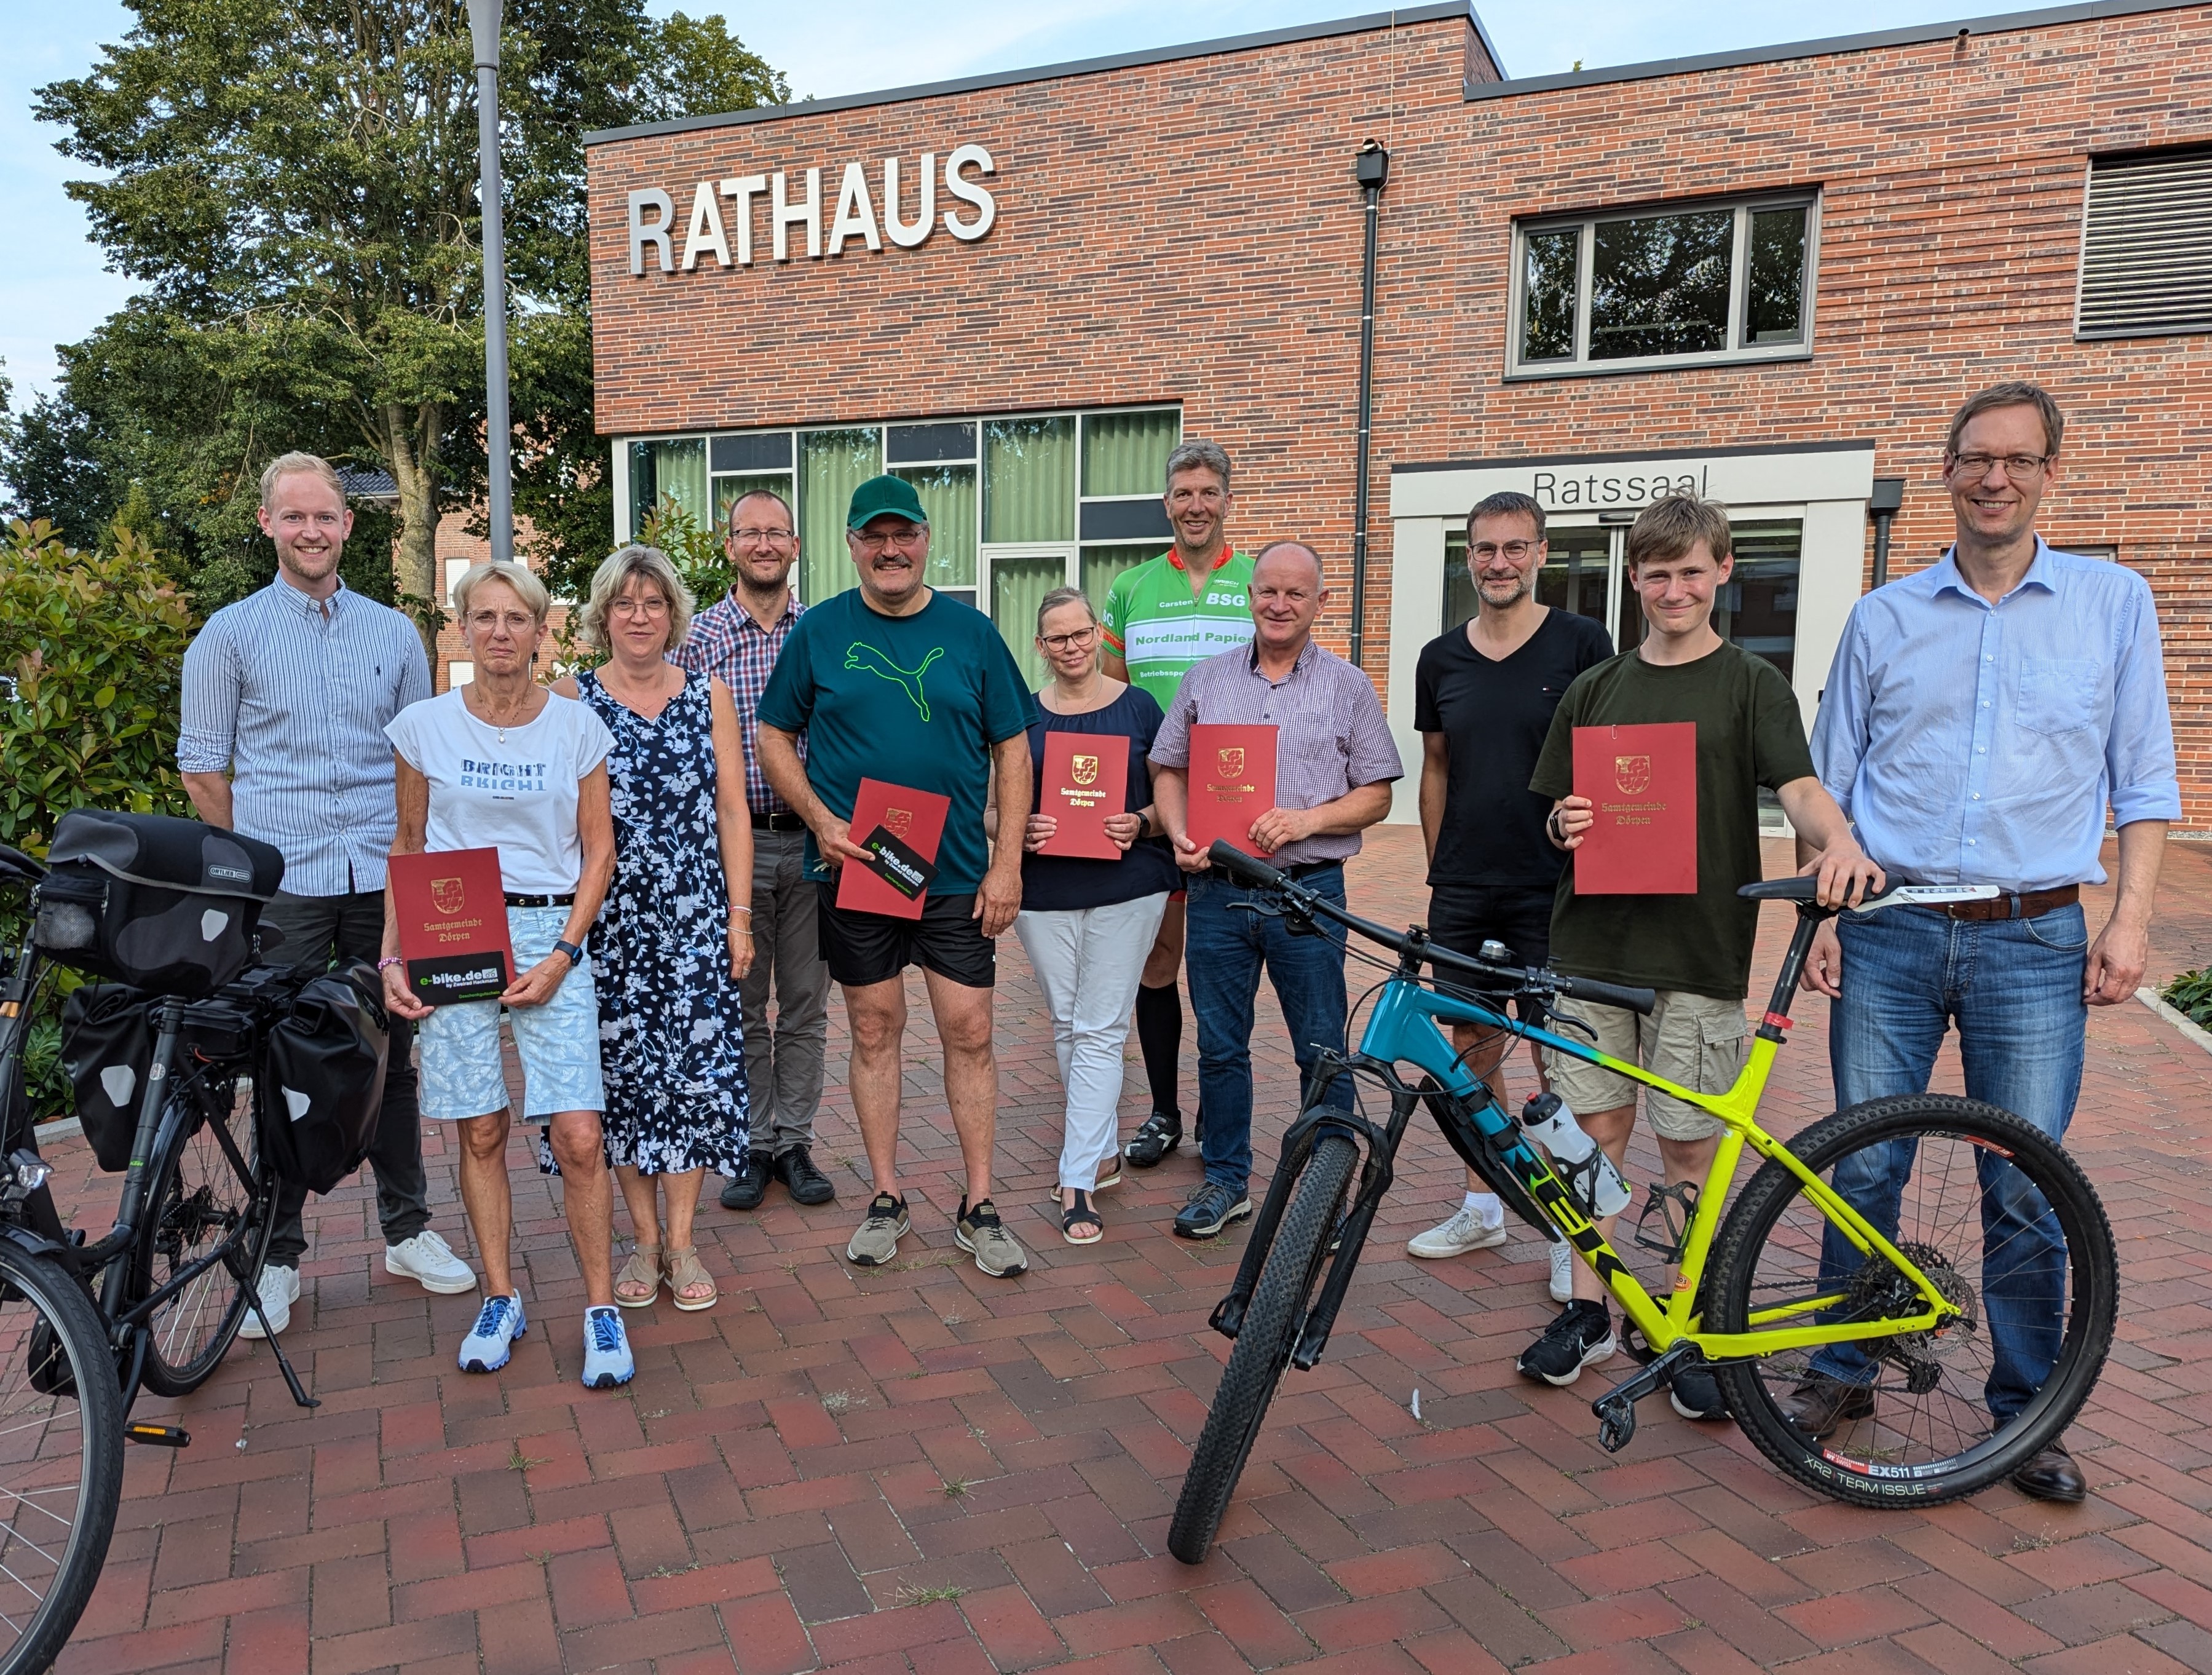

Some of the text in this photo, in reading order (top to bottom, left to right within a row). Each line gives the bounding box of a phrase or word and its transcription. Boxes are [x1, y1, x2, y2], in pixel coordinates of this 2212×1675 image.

[628, 144, 997, 276] RATHAUS
[1534, 465, 1708, 504] Ratssaal
[1159, 593, 1246, 608] Carsten BSG
[1136, 633, 1199, 646] Nordland
[461, 759, 547, 777] BRIGHT
[1061, 788, 1106, 798] Samtgemeinde
[1069, 798, 1095, 807] Dörpen
[1601, 801, 1667, 814] Samtgemeinde
[1616, 815, 1651, 826] Dörpen
[872, 842, 913, 876] e-bike.de
[424, 918, 483, 932] Samtgemeinde
[438, 932, 470, 943] Dörpen
[420, 970, 483, 986] e-bike.de
[1836, 1457, 1852, 1468] SWISS
[1804, 1454, 1832, 1479] XR2
[1837, 1472, 1878, 1494] TEAM
[1882, 1484, 1926, 1495] ISSUE
[1868, 1465, 1910, 1478] EX511
